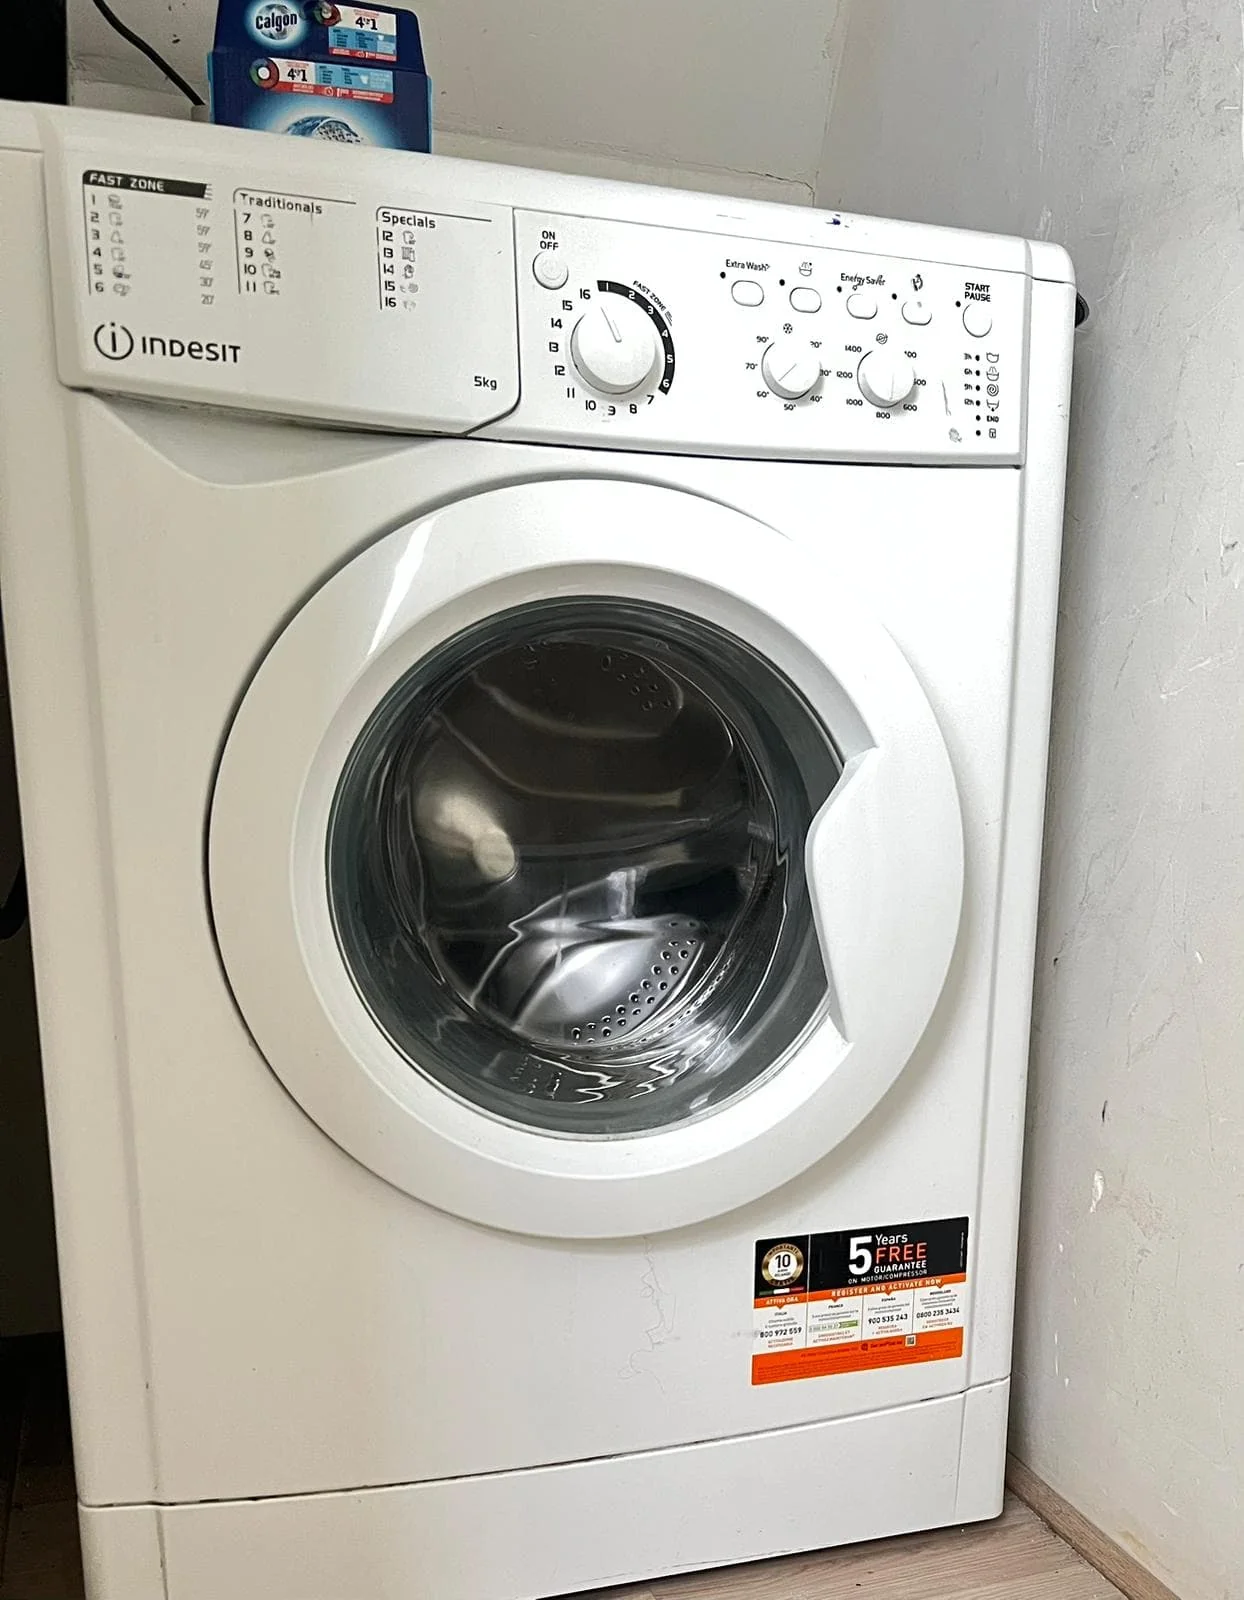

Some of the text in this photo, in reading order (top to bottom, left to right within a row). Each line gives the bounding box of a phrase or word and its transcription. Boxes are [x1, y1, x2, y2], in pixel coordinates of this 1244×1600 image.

[255, 13, 298, 32] Calgon
[90, 173, 165, 192] FAST ZONE
[240, 193, 323, 215] Traditionals
[90, 211, 99, 223] 2
[241, 213, 251, 224] 7
[382, 212, 436, 229] Specials
[91, 229, 100, 240] 3
[244, 230, 252, 241] 8
[382, 231, 393, 242] 12
[541, 231, 556, 241] ON
[540, 240, 559, 251] OFF
[93, 247, 102, 257] 4
[245, 247, 254, 259] 9
[383, 248, 394, 259] 13
[94, 264, 103, 275] 5
[244, 264, 257, 275] 10
[383, 264, 394, 275] 14
[726, 259, 746, 269] Extra
[840, 273, 865, 286] Energy
[95, 281, 104, 293] 6
[246, 281, 257, 293] 11
[384, 281, 396, 292] 15
[964, 282, 991, 293] START
[579, 289, 591, 300] 16
[629, 290, 636, 299] 2
[964, 291, 991, 303] PAUSE
[384, 297, 397, 308] 16
[562, 301, 573, 311] 15
[647, 305, 654, 315] 3
[551, 318, 563, 329] 14
[661, 329, 669, 338] 4
[549, 342, 559, 352] 13
[844, 345, 862, 353] 1400
[666, 354, 673, 364] 5
[555, 365, 566, 376] 12
[745, 362, 759, 370] 70°
[836, 371, 853, 379] 1200
[473, 376, 498, 391] 5kg
[663, 379, 670, 388] 6
[567, 388, 575, 398] 11
[756, 390, 770, 398] 60°
[646, 394, 655, 405] 7
[809, 395, 823, 403] 40°
[845, 398, 863, 407] 1000
[585, 400, 597, 411] 10
[629, 404, 638, 414] 8
[783, 403, 797, 411] 50°
[903, 404, 918, 412] 600
[875, 411, 891, 420] 800
[986, 415, 1000, 423] END
[875, 1233, 909, 1246] Years
[848, 1235, 873, 1275] 5
[876, 1242, 928, 1264] FREE
[775, 1253, 791, 1269] 10
[874, 1260, 927, 1274] GUARANTEE
[847, 1269, 928, 1285] ON MOTOR/COMPRESSOR
[831, 1278, 943, 1297] REGISTER AND ACTIVATE NOW
